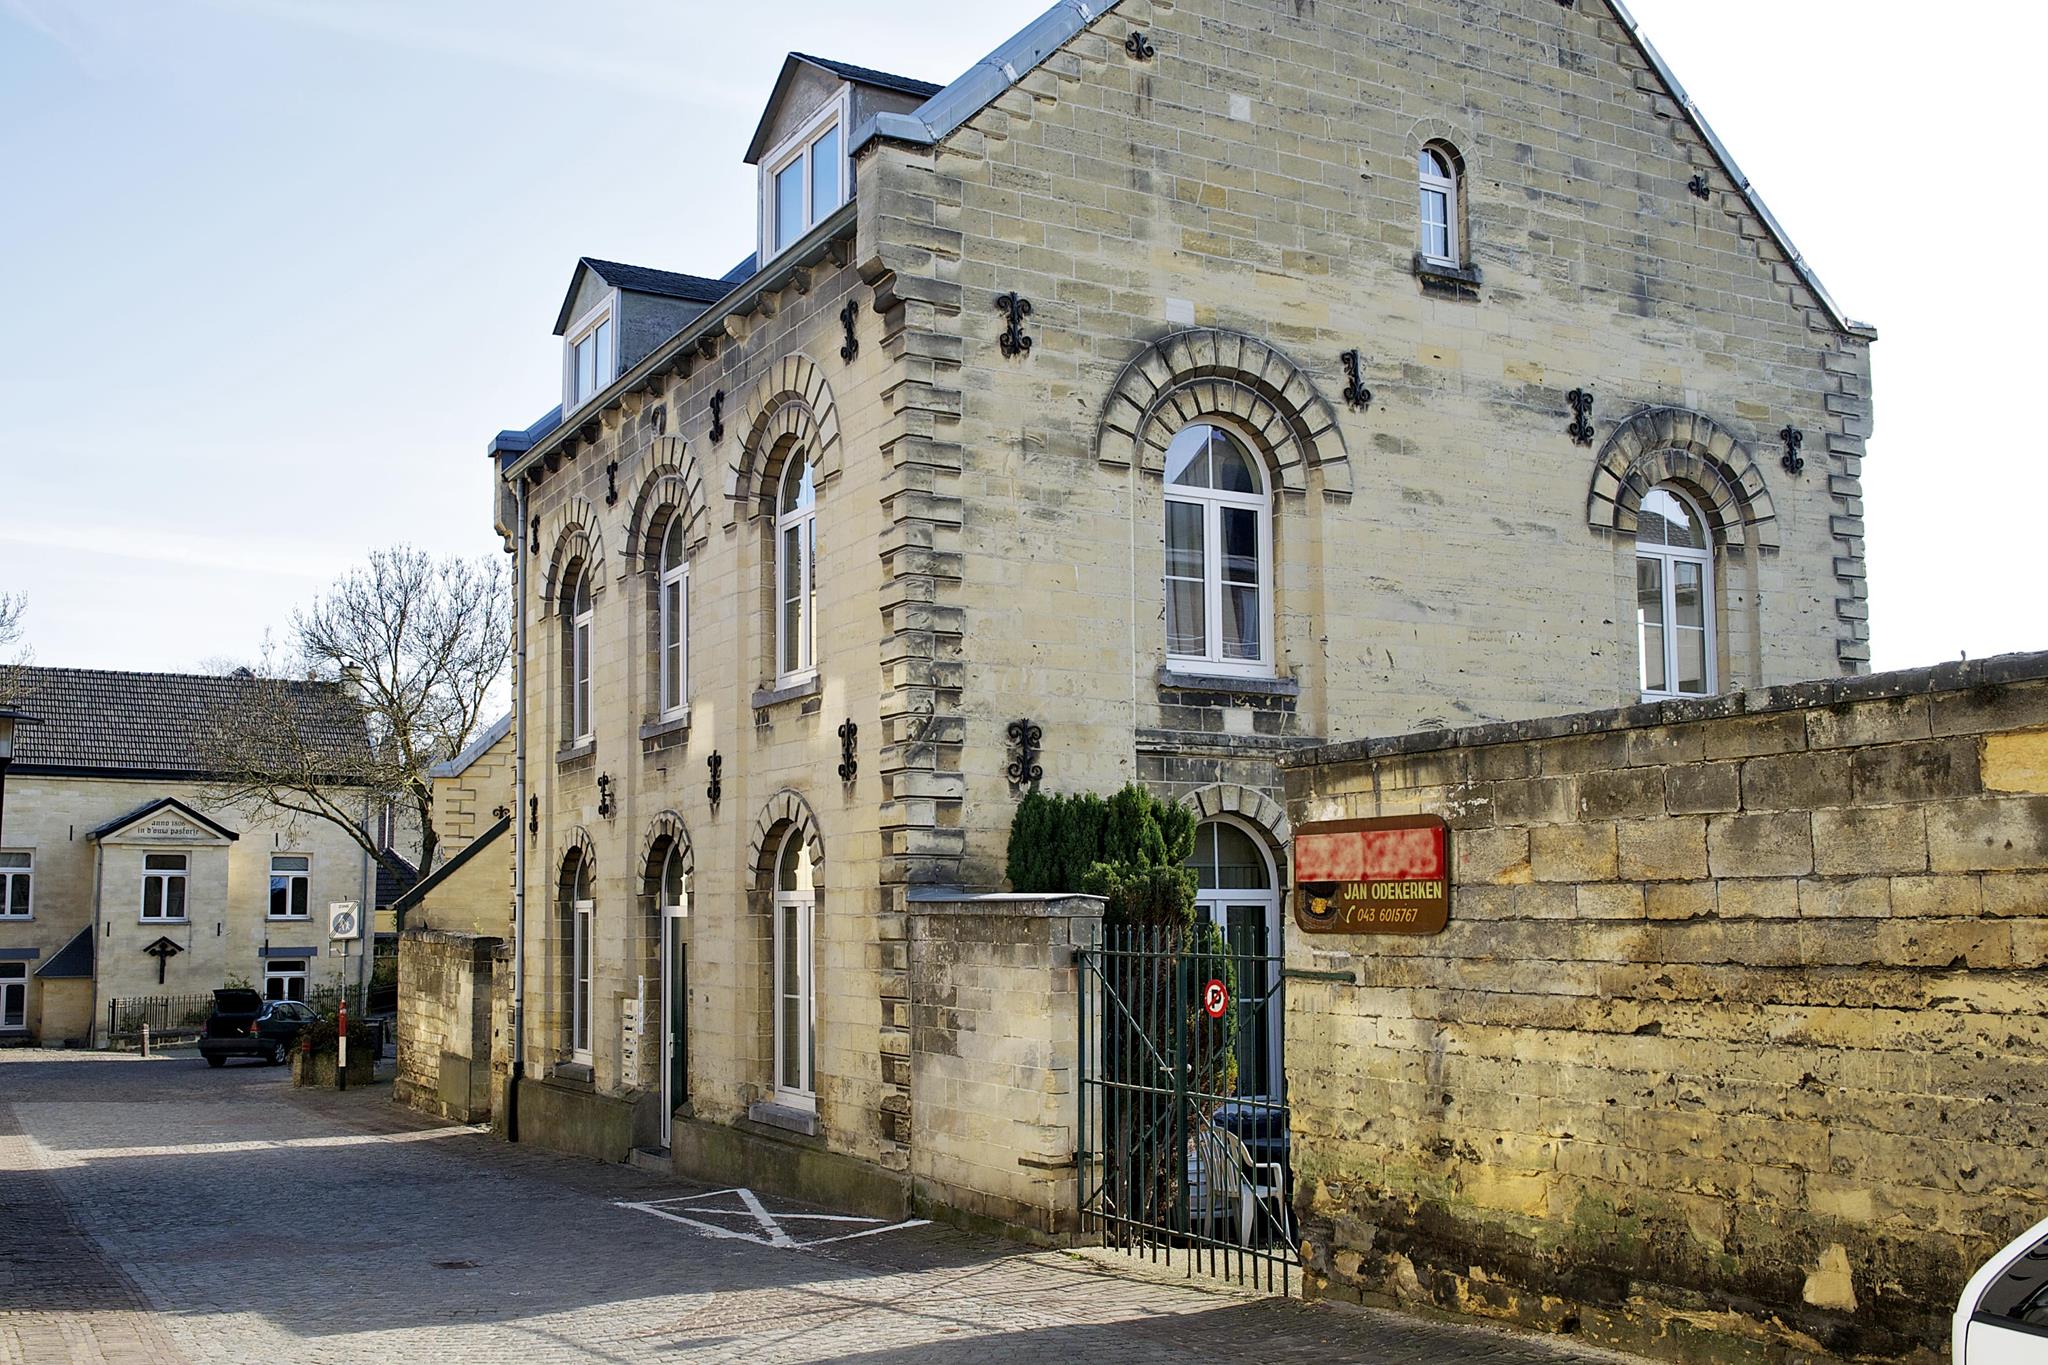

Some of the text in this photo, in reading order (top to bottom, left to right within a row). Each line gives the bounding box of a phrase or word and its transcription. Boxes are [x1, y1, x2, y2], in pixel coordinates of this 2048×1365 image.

[1344, 881, 1442, 900] JAN ODEKERKEN
[1357, 908, 1418, 922] 043 6015767
